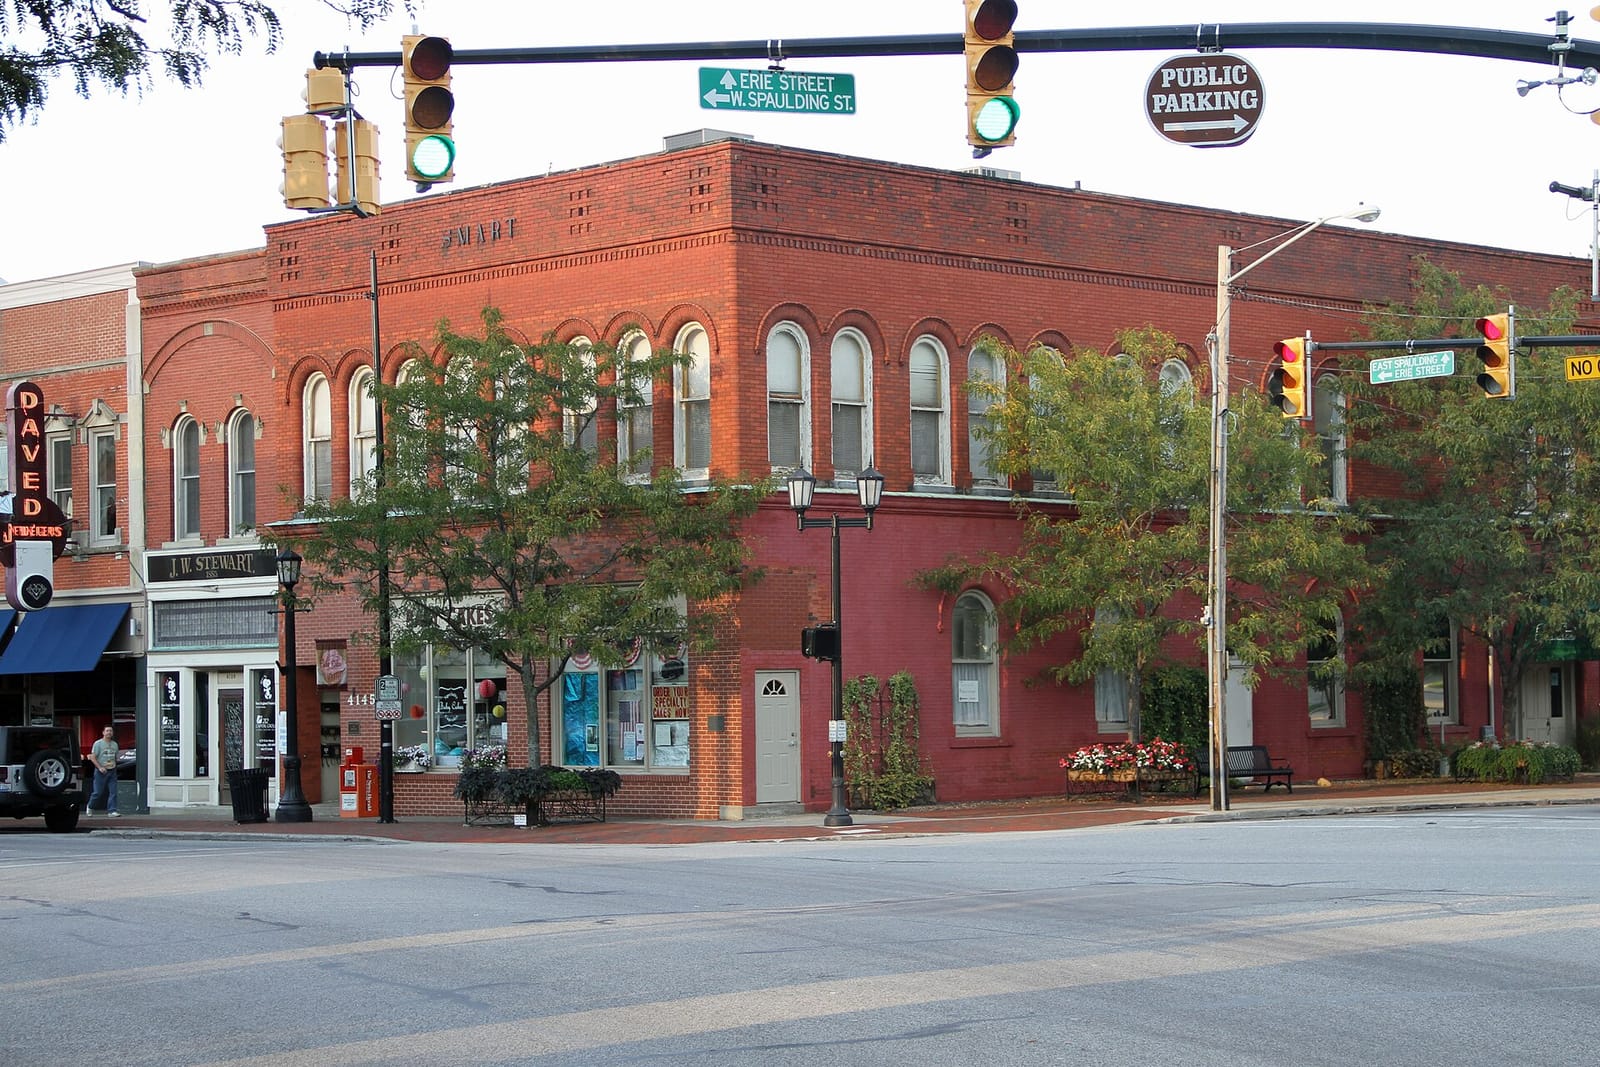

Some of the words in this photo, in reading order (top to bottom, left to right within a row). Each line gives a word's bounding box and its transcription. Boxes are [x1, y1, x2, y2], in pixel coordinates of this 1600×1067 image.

[740, 73, 773, 90] ERIE
[779, 75, 835, 92] STREET
[1161, 65, 1248, 88] PUBLIC
[748, 92, 830, 110] SPAULDING
[833, 95, 854, 111] ST.
[1152, 89, 1258, 113] PARKING
[1372, 361, 1393, 371] EAST
[1394, 355, 1437, 369] SPAULDING
[1395, 368, 1413, 378] ERIE
[1415, 364, 1446, 376] STREET
[1571, 360, 1592, 377] NO
[169, 558, 179, 578] J.
[180, 557, 192, 574] W.
[347, 693, 376, 706] 4145
